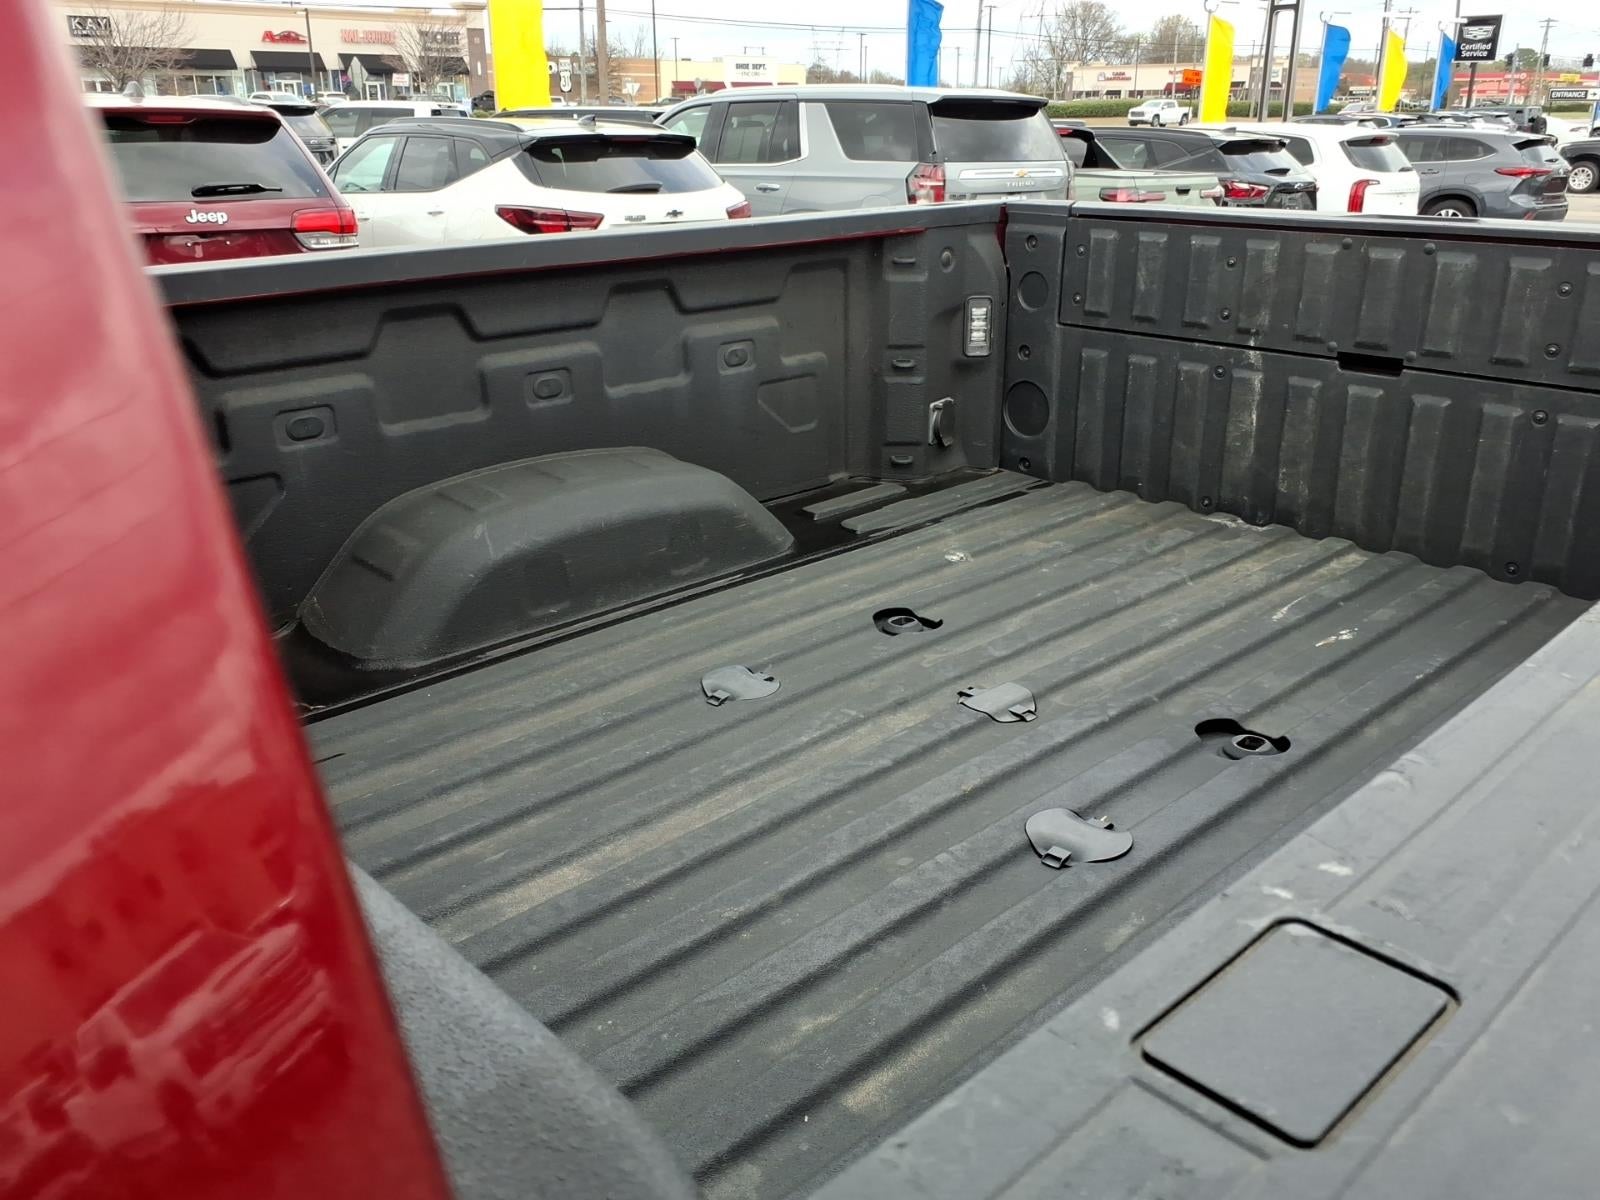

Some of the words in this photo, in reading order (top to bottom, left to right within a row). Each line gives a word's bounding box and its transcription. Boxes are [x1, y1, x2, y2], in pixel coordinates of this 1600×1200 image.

[71, 17, 107, 30] KAY
[1460, 42, 1492, 50] Certified
[1551, 90, 1586, 98] ENTRANCE
[185, 209, 228, 225] Jeep
